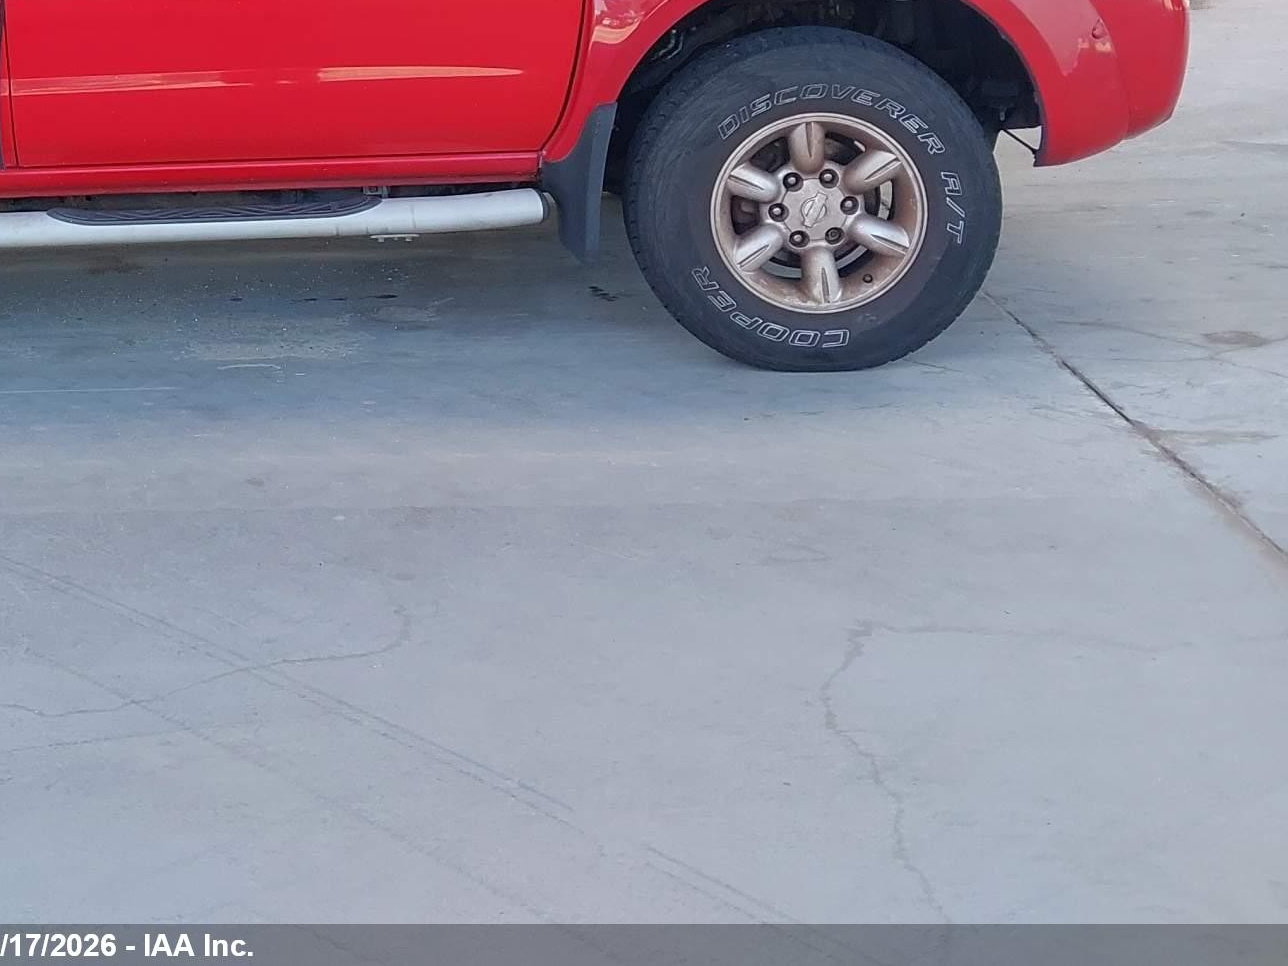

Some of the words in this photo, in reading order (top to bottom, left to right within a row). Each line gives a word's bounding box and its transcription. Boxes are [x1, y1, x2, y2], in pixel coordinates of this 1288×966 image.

[718, 84, 946, 155] DISCOVERER
[941, 171, 966, 245] A/T
[691, 266, 850, 349] COOPER
